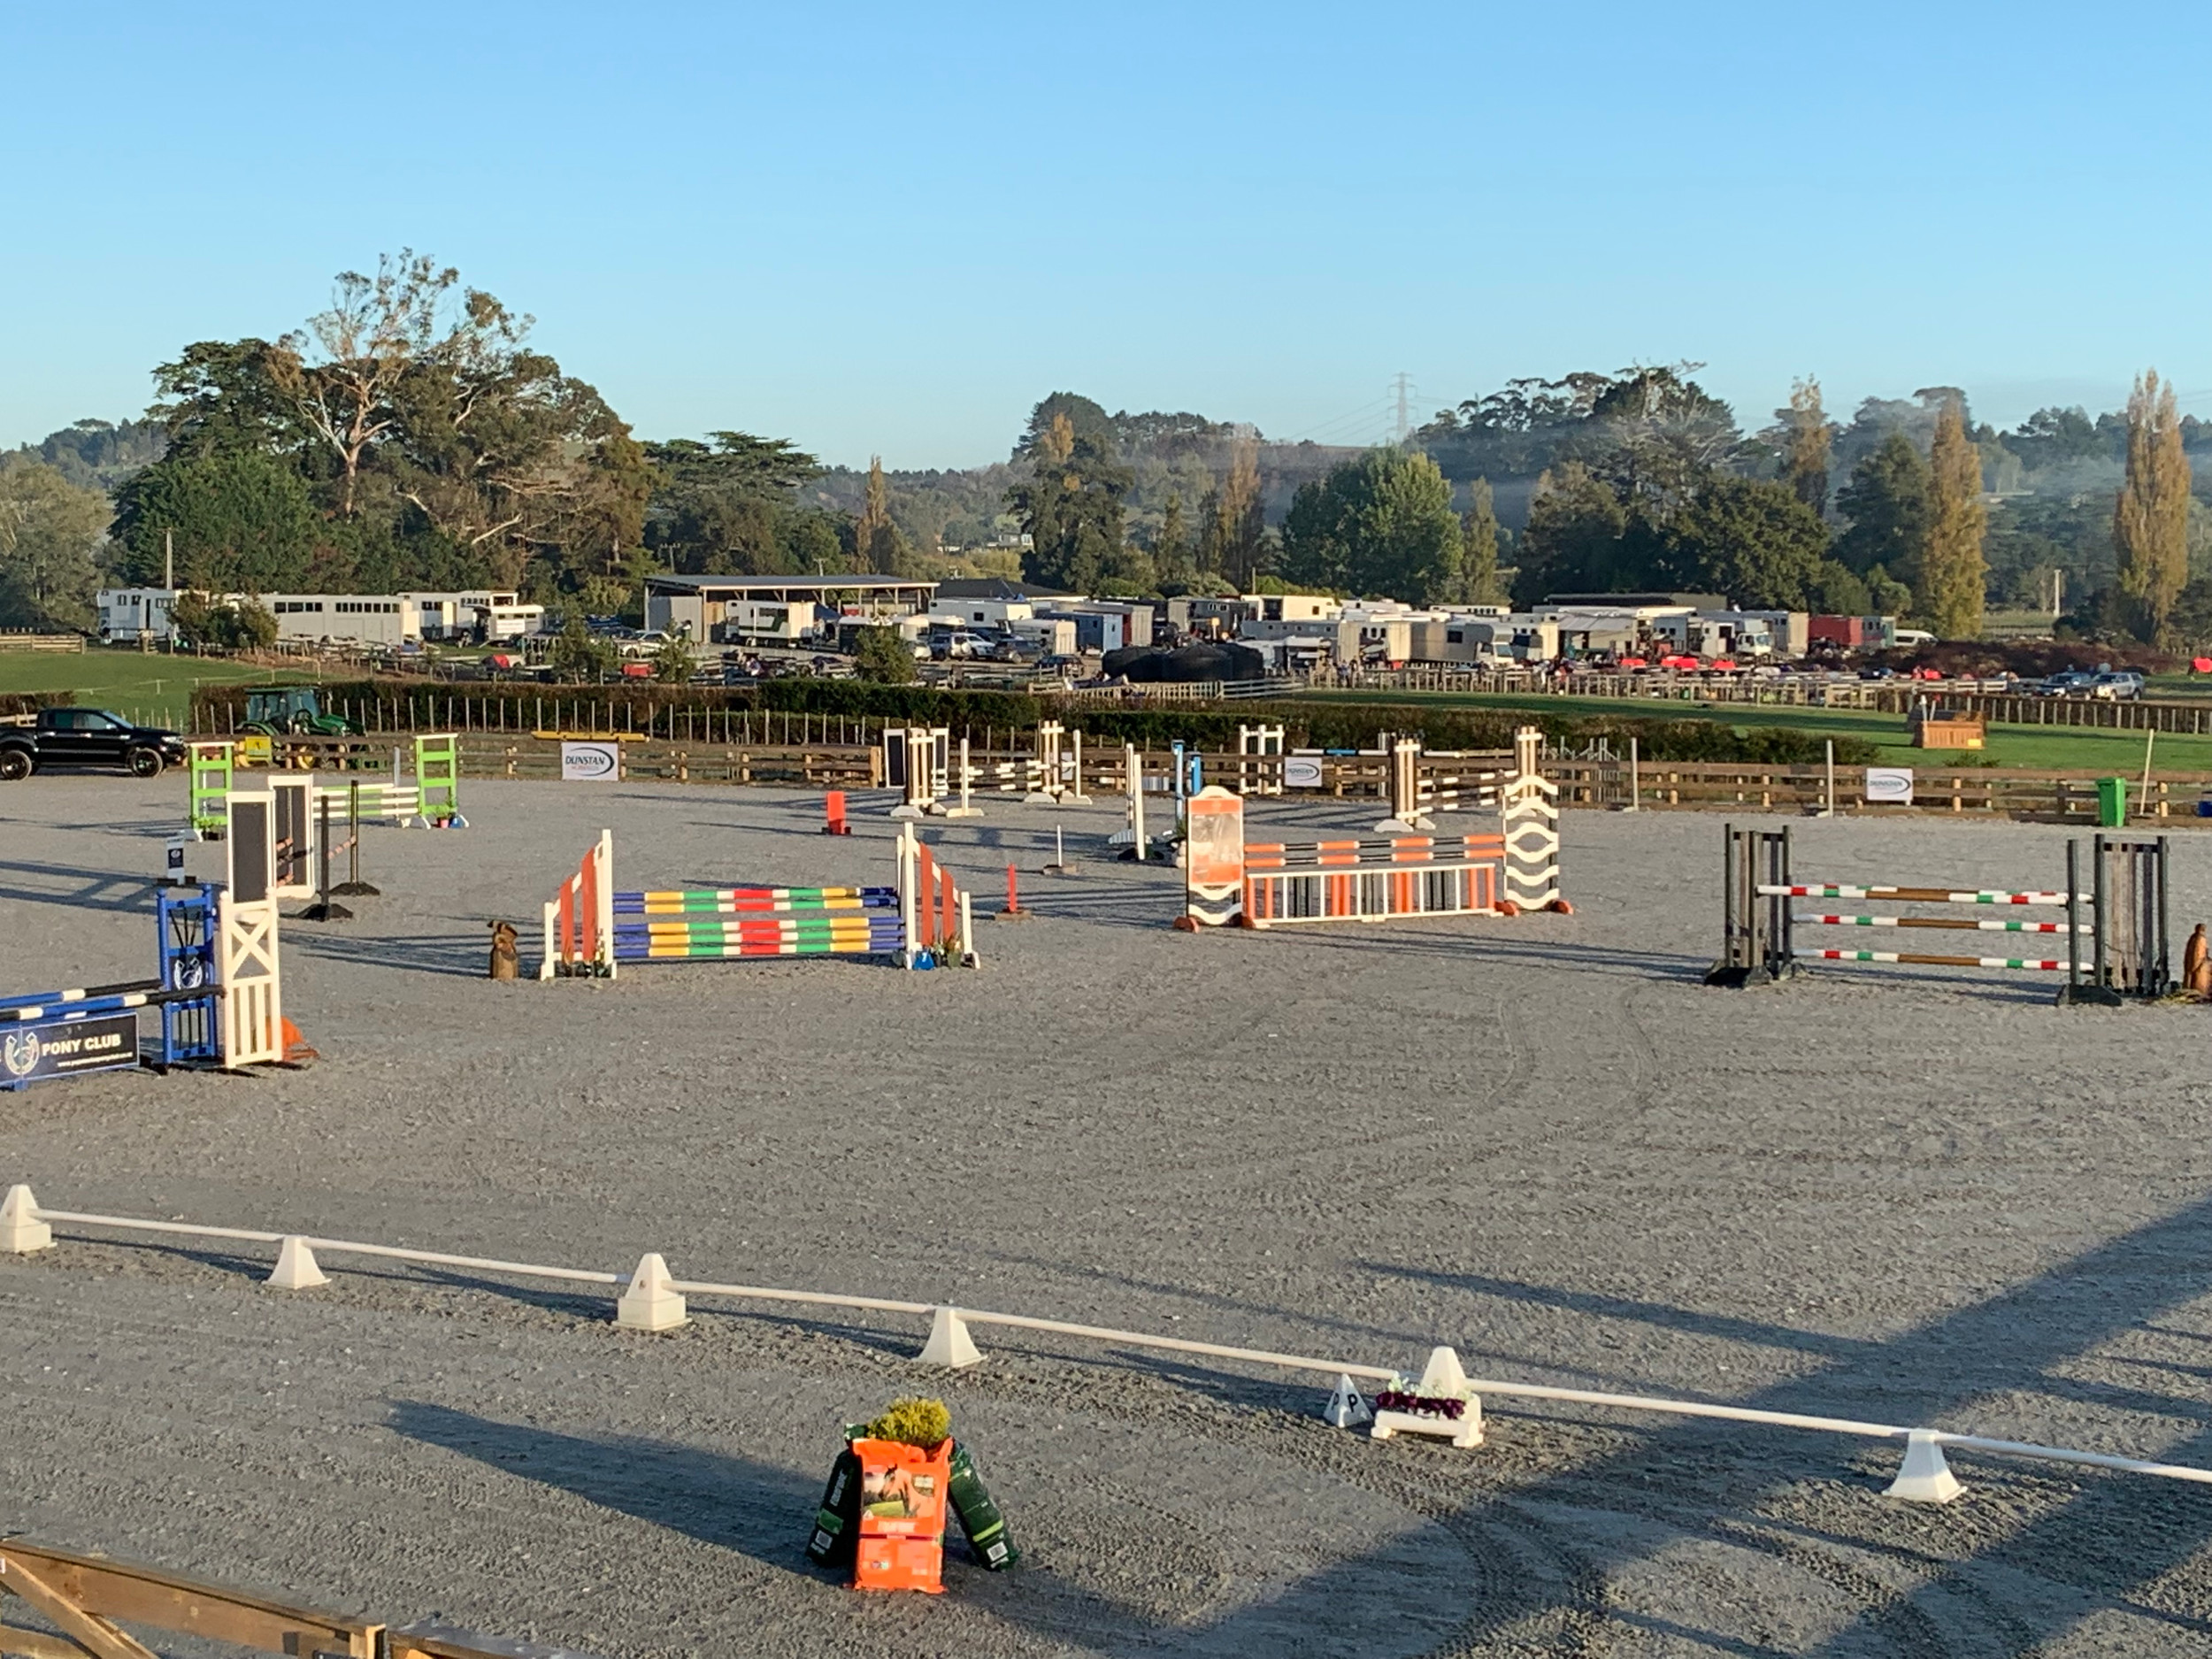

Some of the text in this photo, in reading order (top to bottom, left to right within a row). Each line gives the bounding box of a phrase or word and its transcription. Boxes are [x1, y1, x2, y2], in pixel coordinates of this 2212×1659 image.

[565, 755, 605, 765] DUNSTAN
[42, 1033, 121, 1056] PONY CLUB
[1331, 1392, 1340, 1411] P
[1347, 1394, 1358, 1413] P
